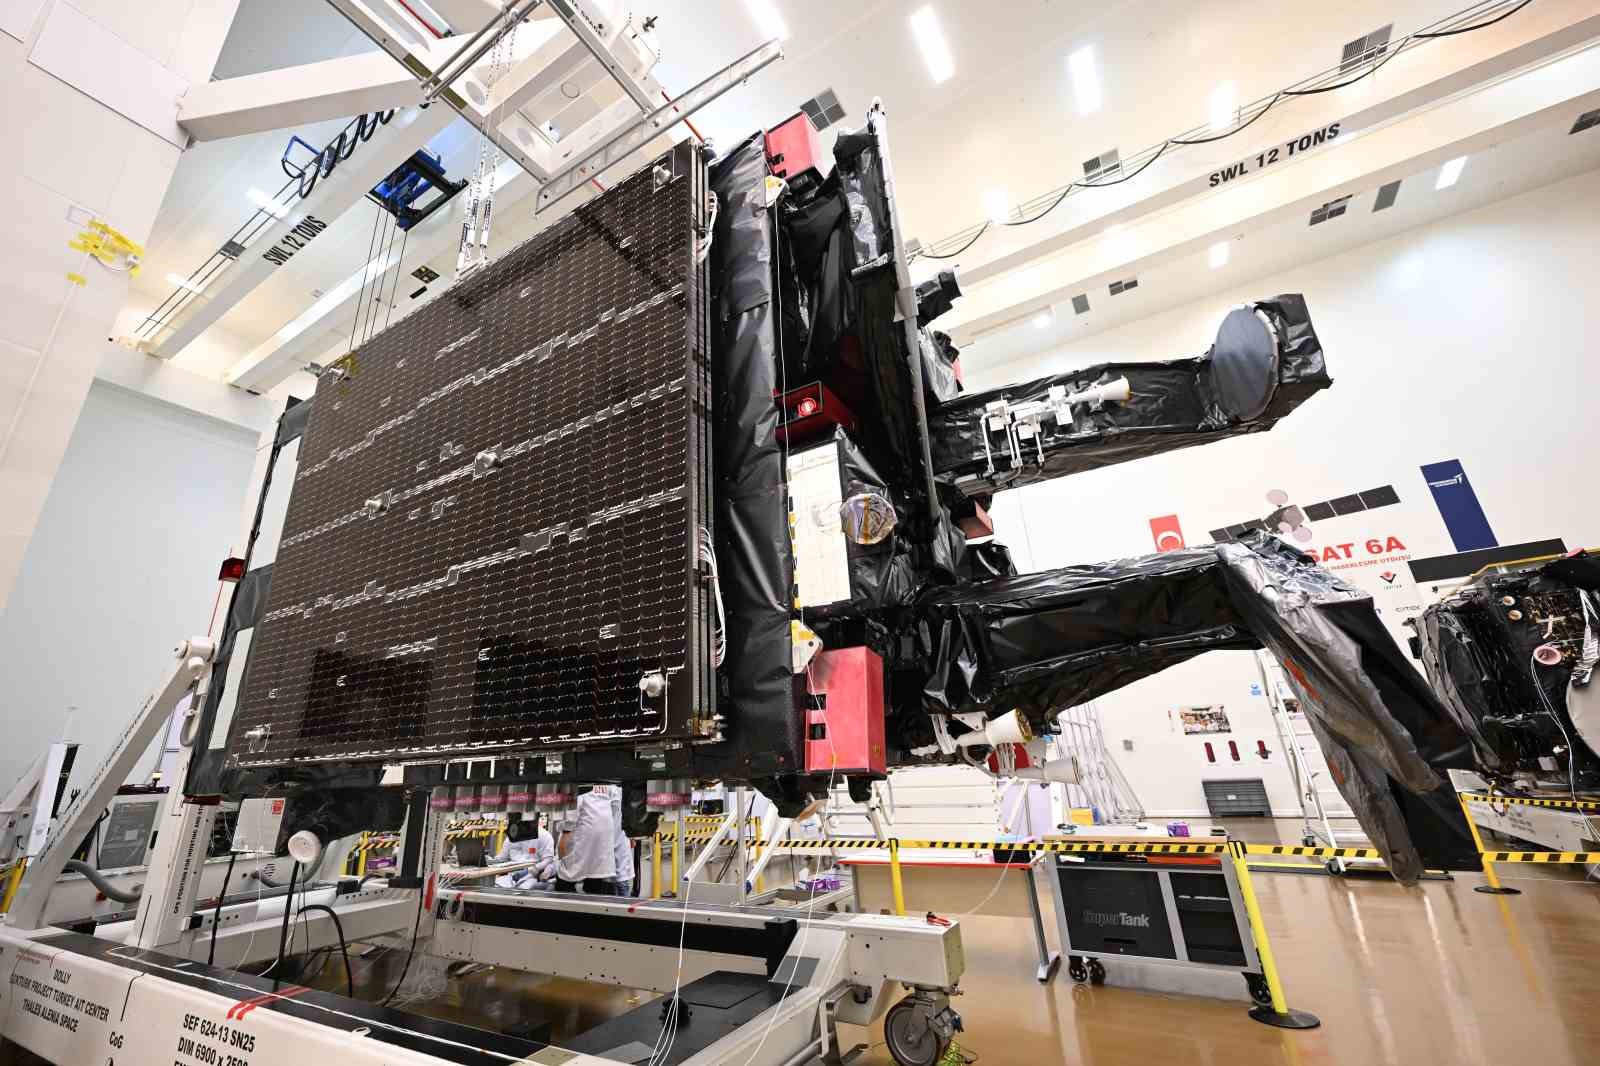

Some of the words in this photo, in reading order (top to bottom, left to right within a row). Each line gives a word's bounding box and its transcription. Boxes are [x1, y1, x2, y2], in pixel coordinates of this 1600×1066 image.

[1209, 162, 1249, 188] SWL
[1256, 148, 1279, 168] 12
[1286, 123, 1340, 156] TONS
[290, 215, 328, 241] TONS
[281, 235, 305, 250] 12
[262, 246, 294, 266] SWL
[1365, 536, 1407, 555] 6A
[53, 969, 71, 984] DOLLY
[22, 999, 41, 1017] THALES
[40, 1006, 60, 1024] ALENIA
[59, 1014, 79, 1033] SPACE
[53, 989, 77, 1009] TURKEY
[85, 1001, 110, 1022] CENTER
[109, 1031, 124, 1049] CoG
[183, 1013, 200, 1032] SEF
[200, 1020, 229, 1042] 624-13
[230, 1030, 256, 1053] SN25
[177, 1037, 195, 1056] DIM
[195, 1043, 217, 1065] 6900
